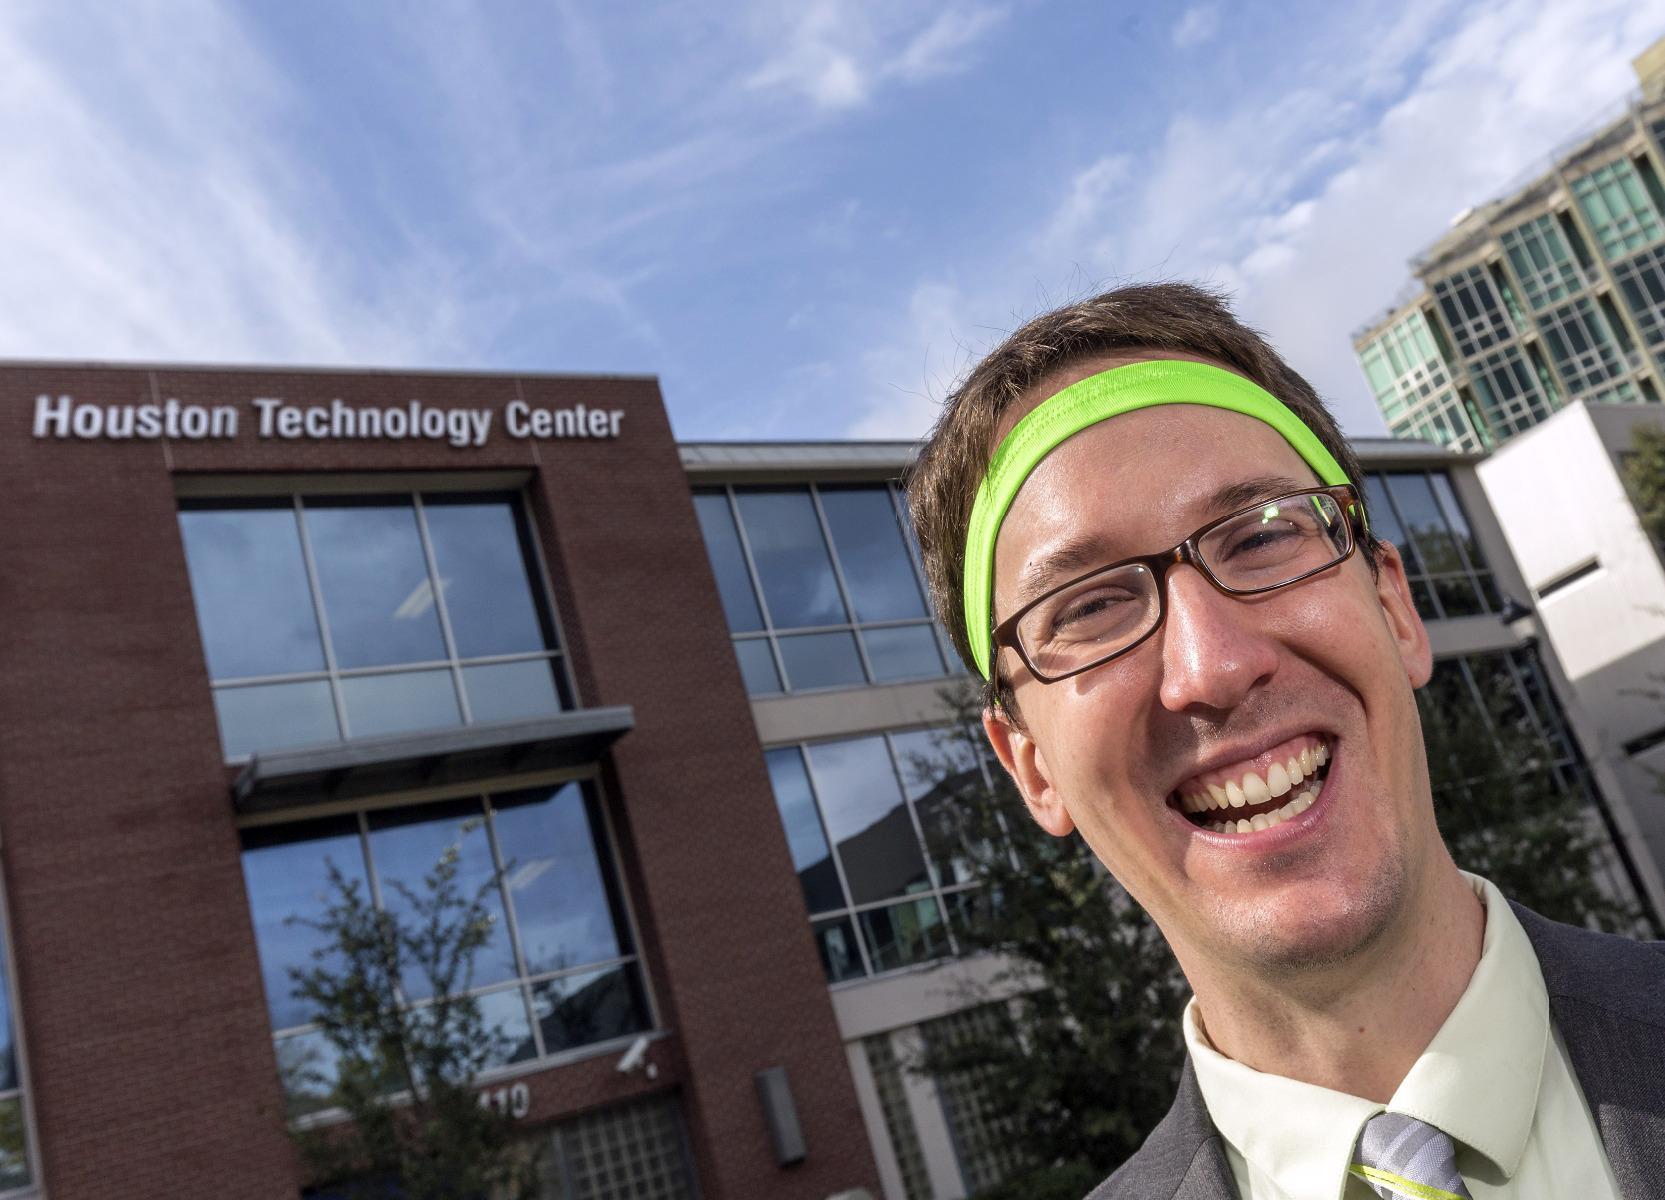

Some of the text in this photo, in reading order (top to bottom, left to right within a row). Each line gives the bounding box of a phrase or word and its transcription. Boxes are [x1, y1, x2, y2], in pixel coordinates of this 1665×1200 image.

[32, 394, 625, 447] Houston Technology Center
